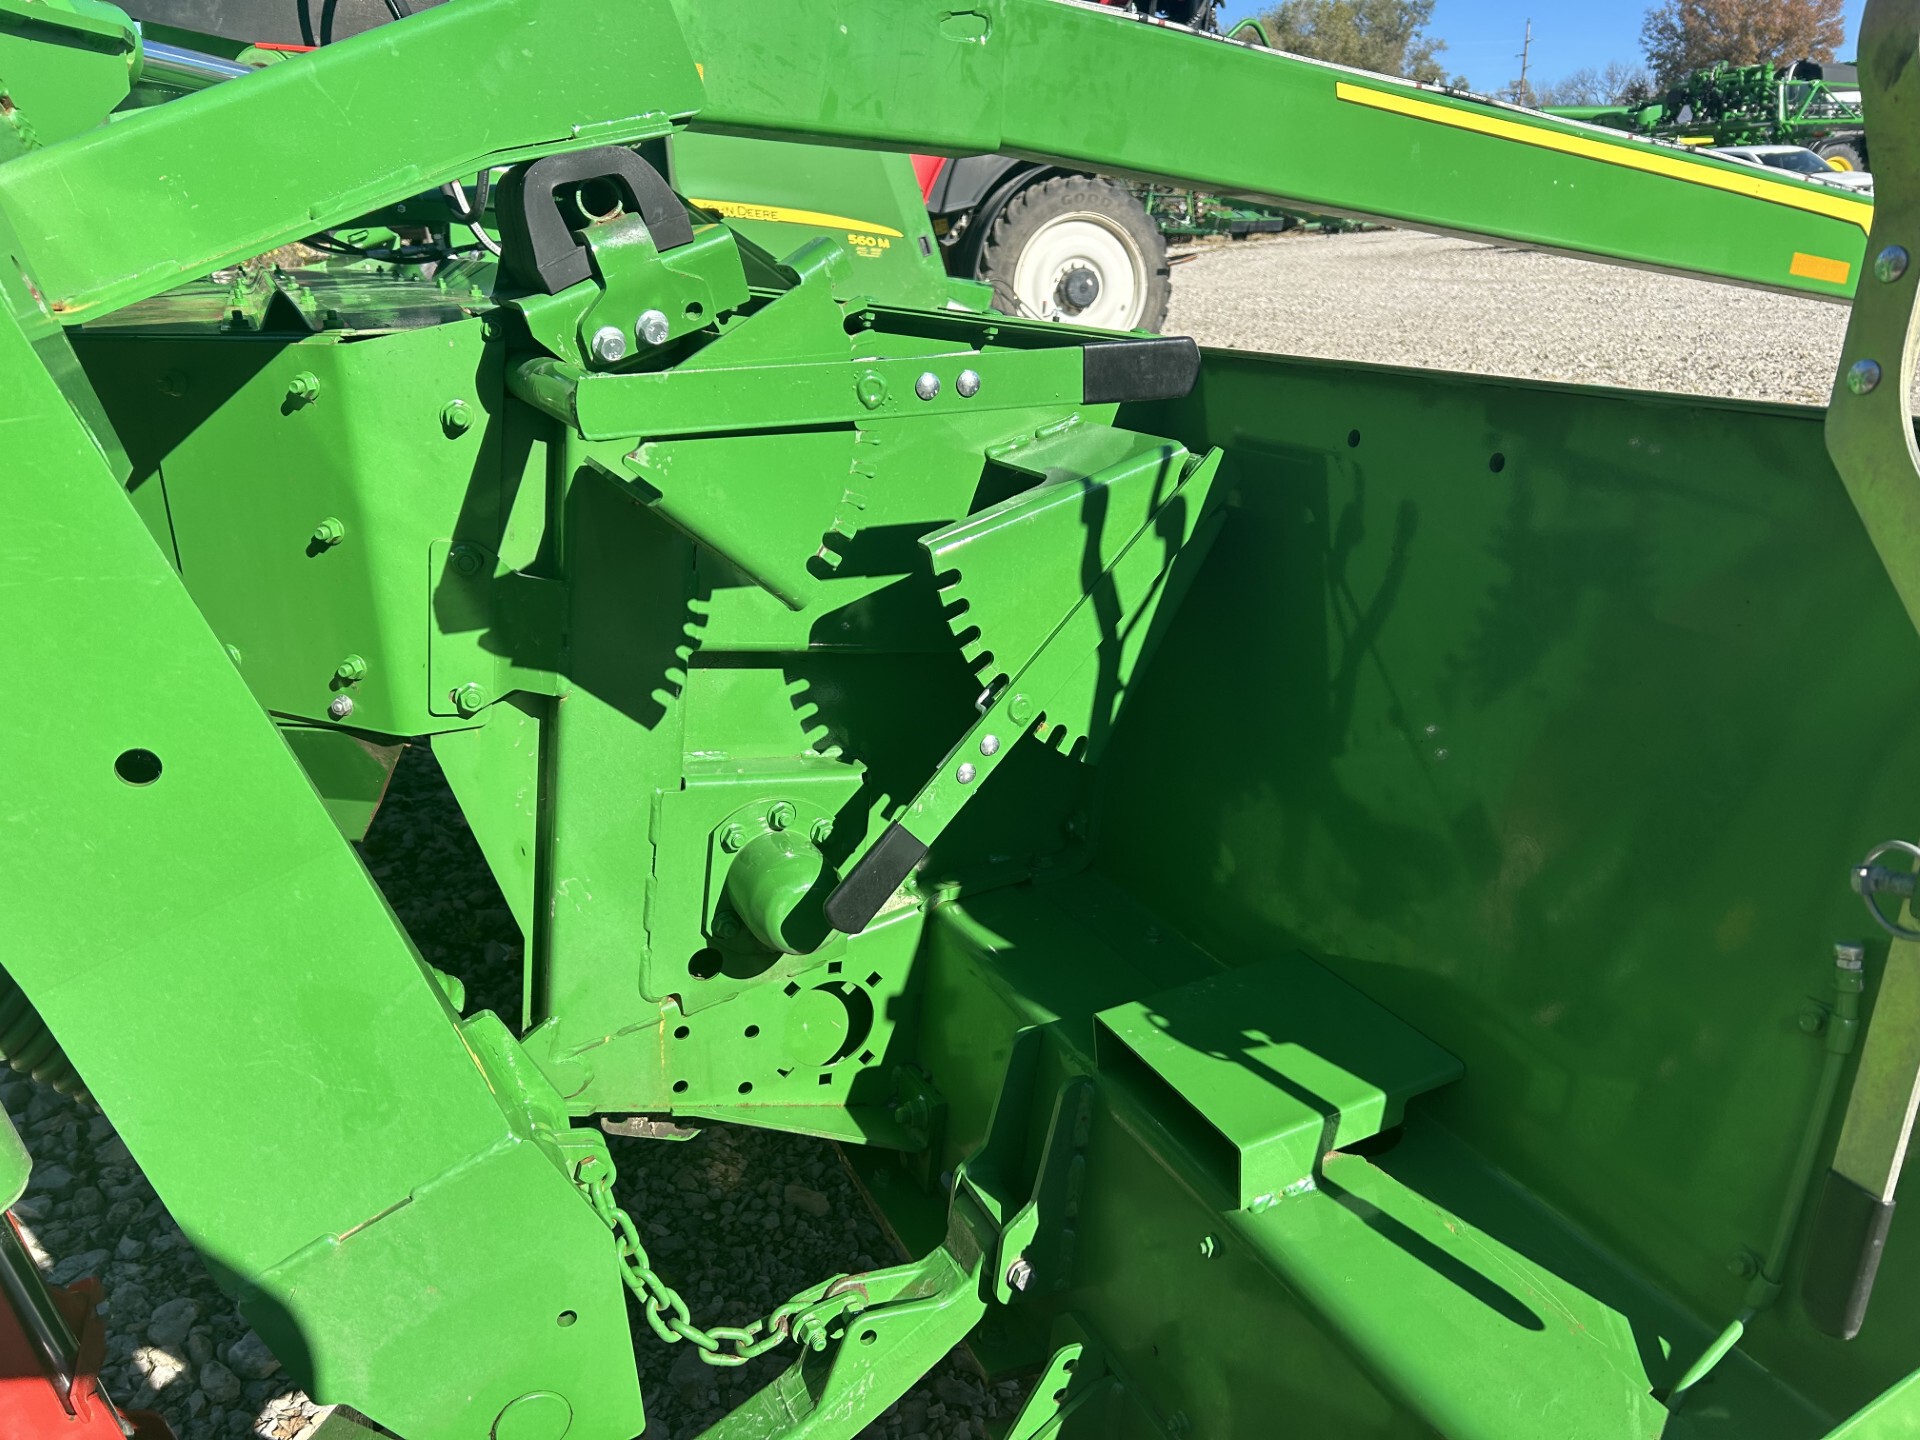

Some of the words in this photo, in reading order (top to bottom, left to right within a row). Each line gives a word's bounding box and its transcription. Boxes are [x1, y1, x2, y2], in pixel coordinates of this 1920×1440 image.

[737, 205, 779, 220] DEERE
[847, 234, 877, 247] 560
[877, 237, 890, 249] M
